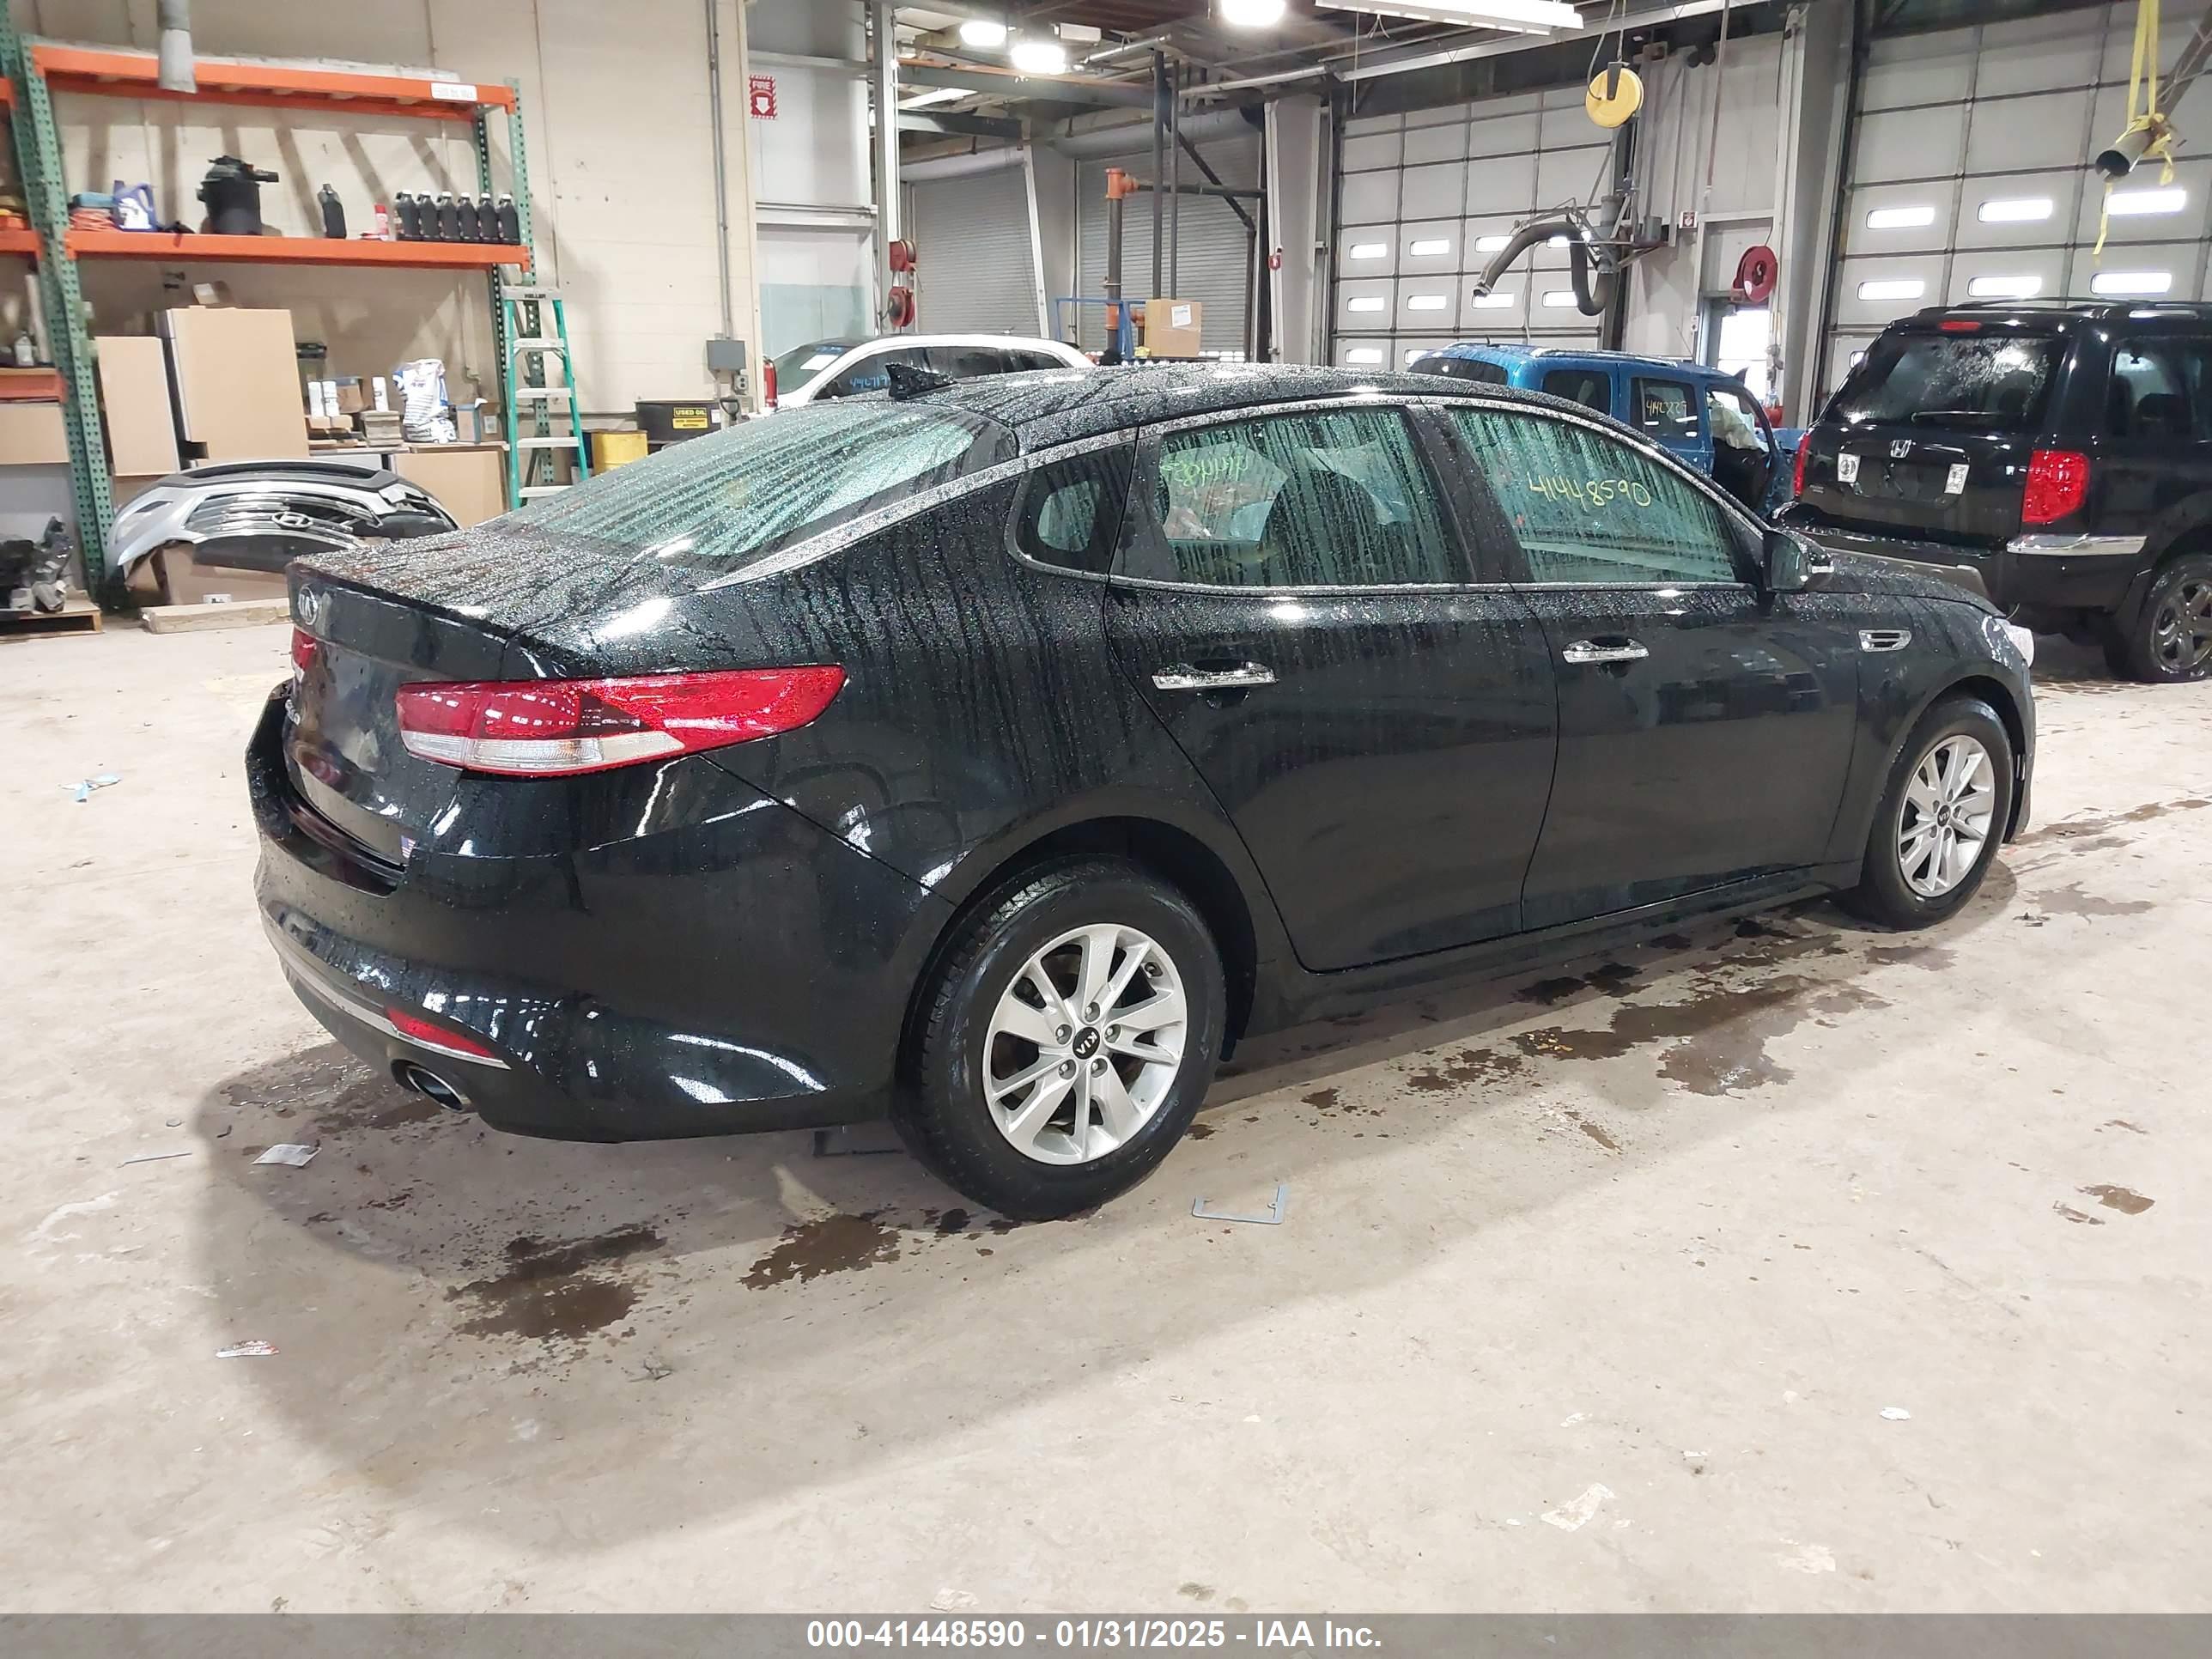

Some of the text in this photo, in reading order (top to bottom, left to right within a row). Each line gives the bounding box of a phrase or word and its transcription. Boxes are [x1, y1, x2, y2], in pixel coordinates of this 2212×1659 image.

[752, 81, 772, 89] FIRE
[1526, 471, 1651, 513] 41448590
[1075, 1030, 1098, 1054] KIA
